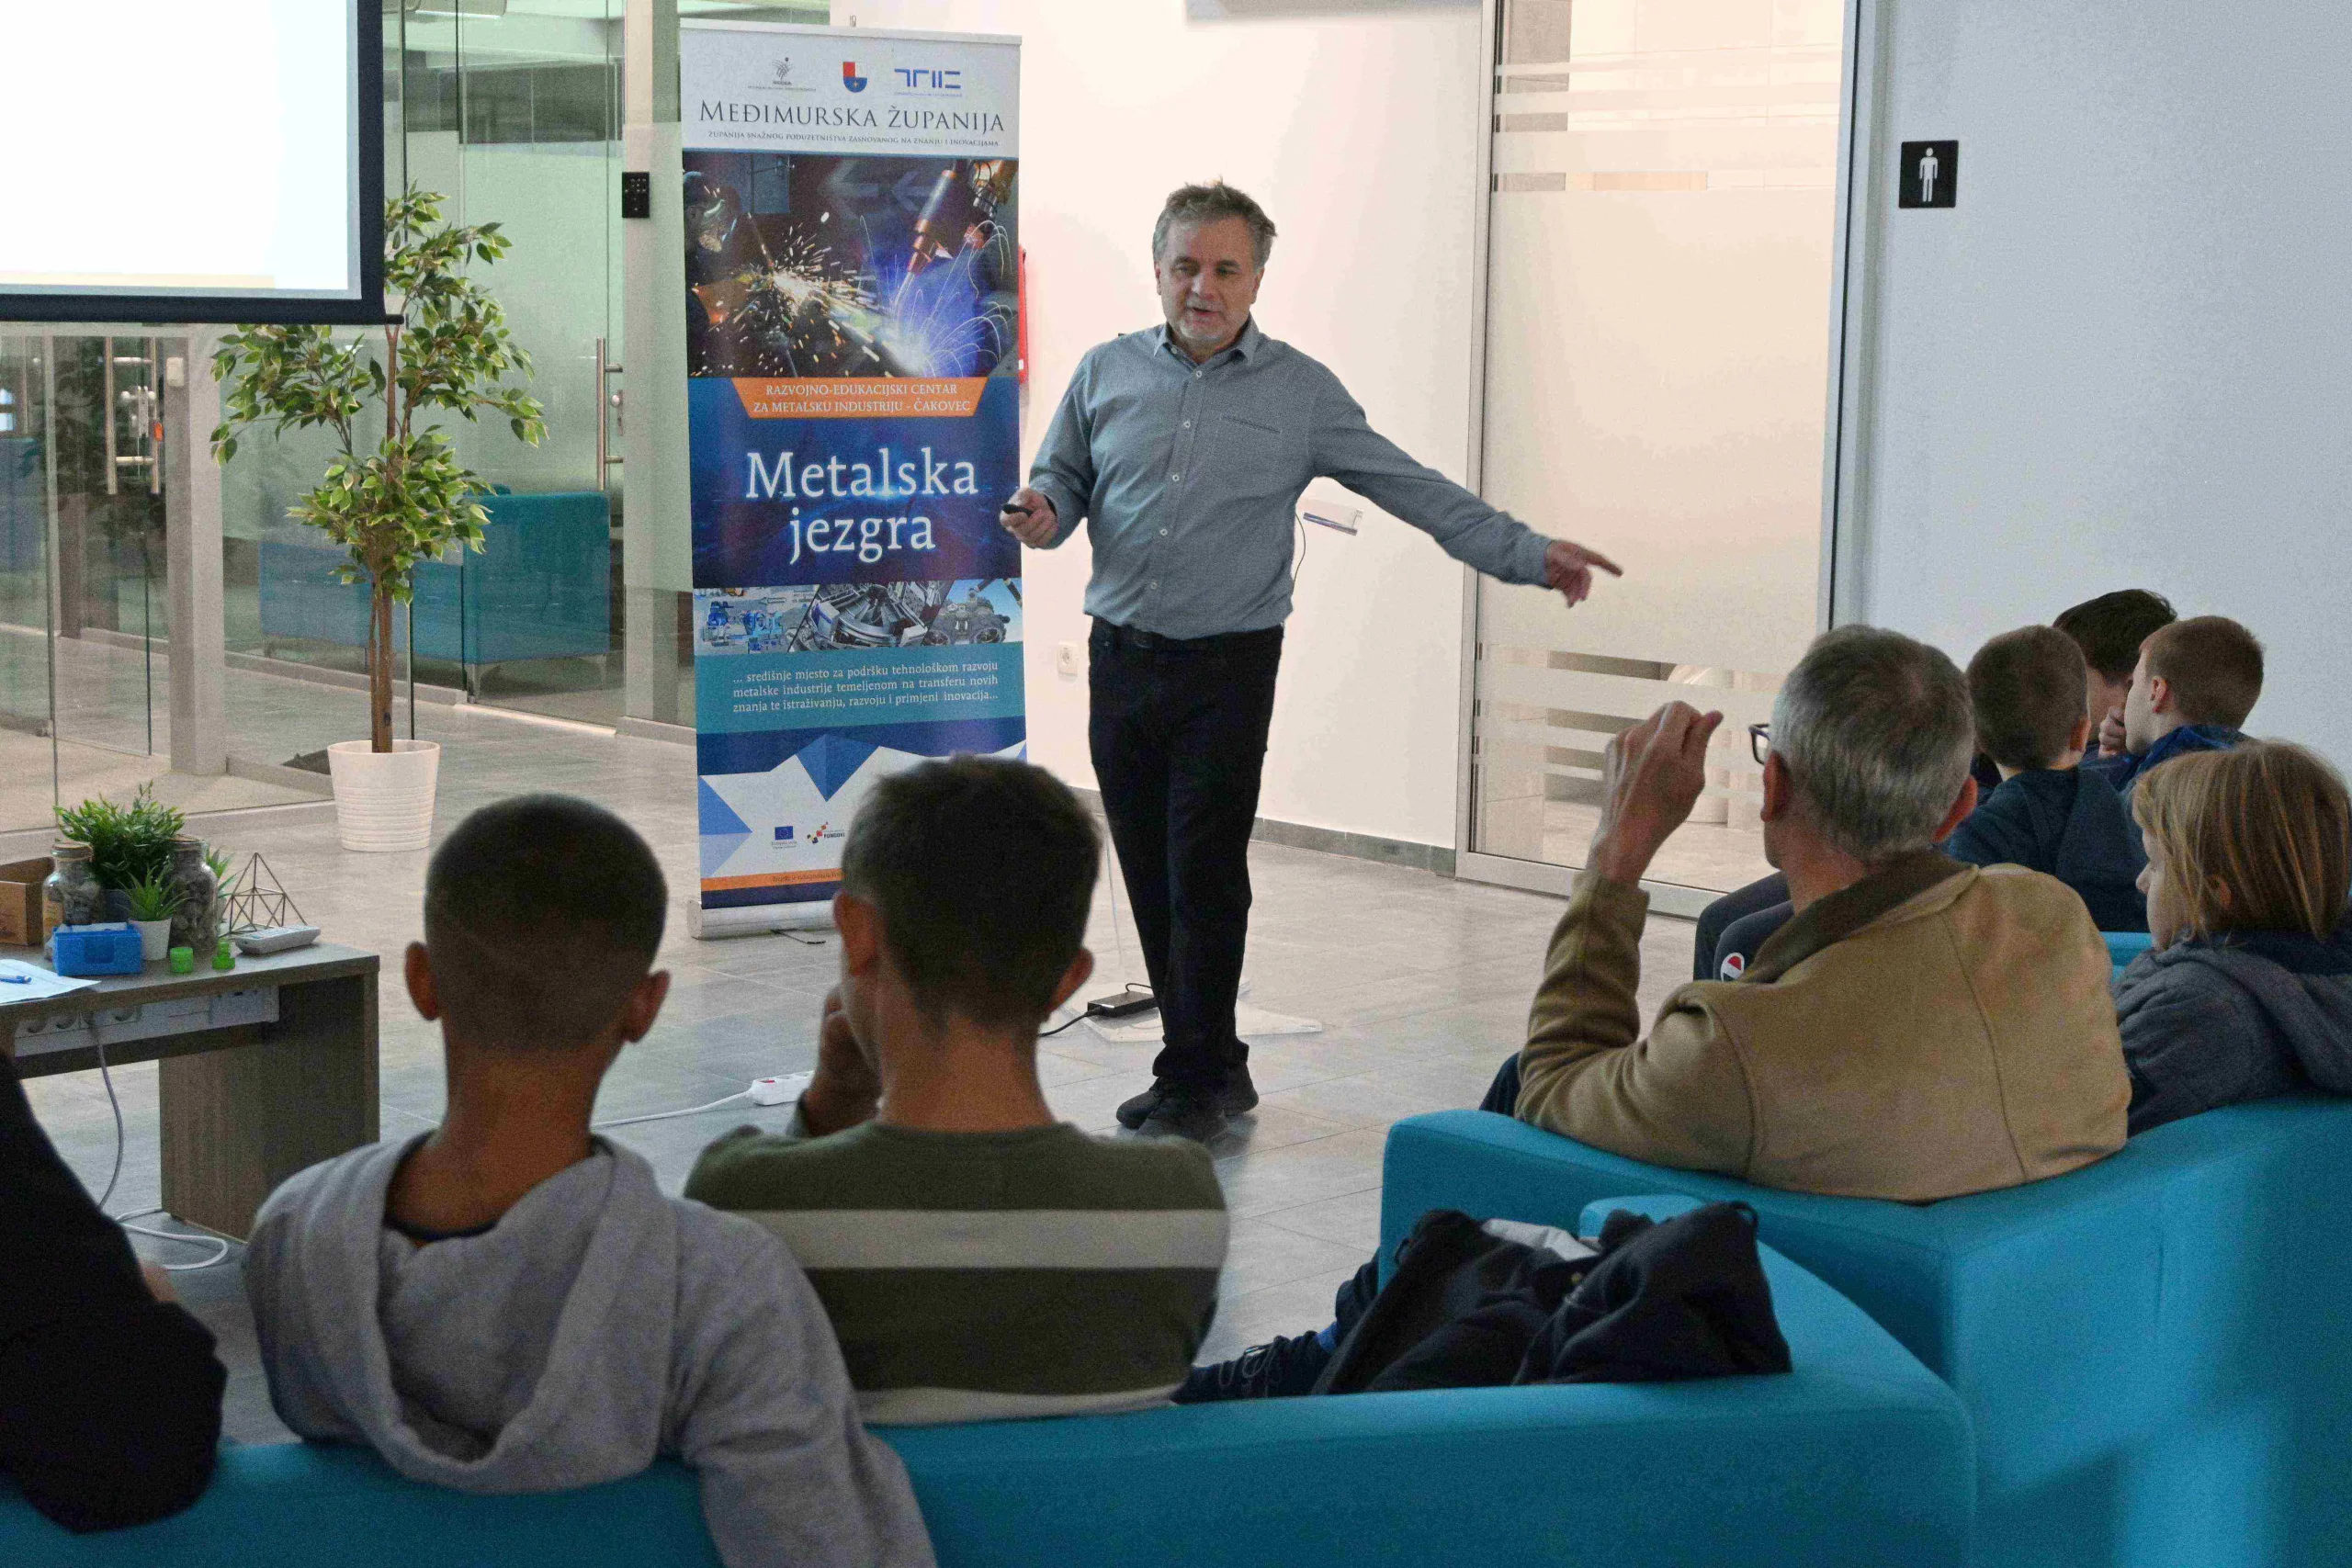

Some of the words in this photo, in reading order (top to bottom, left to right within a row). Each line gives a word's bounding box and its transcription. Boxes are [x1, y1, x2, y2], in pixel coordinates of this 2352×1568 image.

[699, 100, 877, 127] MEĐIMURSKA
[888, 105, 1005, 135] ŽUPANIJA
[708, 130, 745, 140] ŽUPANIJA
[747, 131, 784, 140] SNAŽNOG
[786, 132, 847, 141] PODUZETNIŠTVA
[849, 135, 899, 144] ZASNOVANOG
[950, 139, 1000, 147] INOVACIJAMA
[766, 384, 908, 396] RAZVOJNO-EDUKACIJSKI
[910, 384, 957, 395] CENTAR
[753, 402, 769, 412] ZA
[772, 402, 831, 412] METALSKU
[834, 400, 903, 412] INDUSTRIJU
[913, 397, 970, 412] ČAKOVEC
[746, 447, 978, 499] Metalska
[789, 507, 936, 565] jezgra
[747, 671, 792, 682] središnje
[796, 669, 830, 681] mjesto
[847, 665, 888, 680] podršku
[892, 663, 959, 675] tehnološkom
[963, 660, 999, 672] razvoju
[733, 684, 779, 697] metalske
[783, 682, 832, 694] industrije
[837, 681, 898, 693] temeljenom
[919, 676, 966, 688] transferu
[970, 674, 998, 685] novih
[733, 701, 767, 712] znanja
[771, 701, 780, 710] te
[783, 696, 845, 710] istraživanju,
[849, 694, 886, 706] razvoju
[895, 692, 938, 705] primjeni
